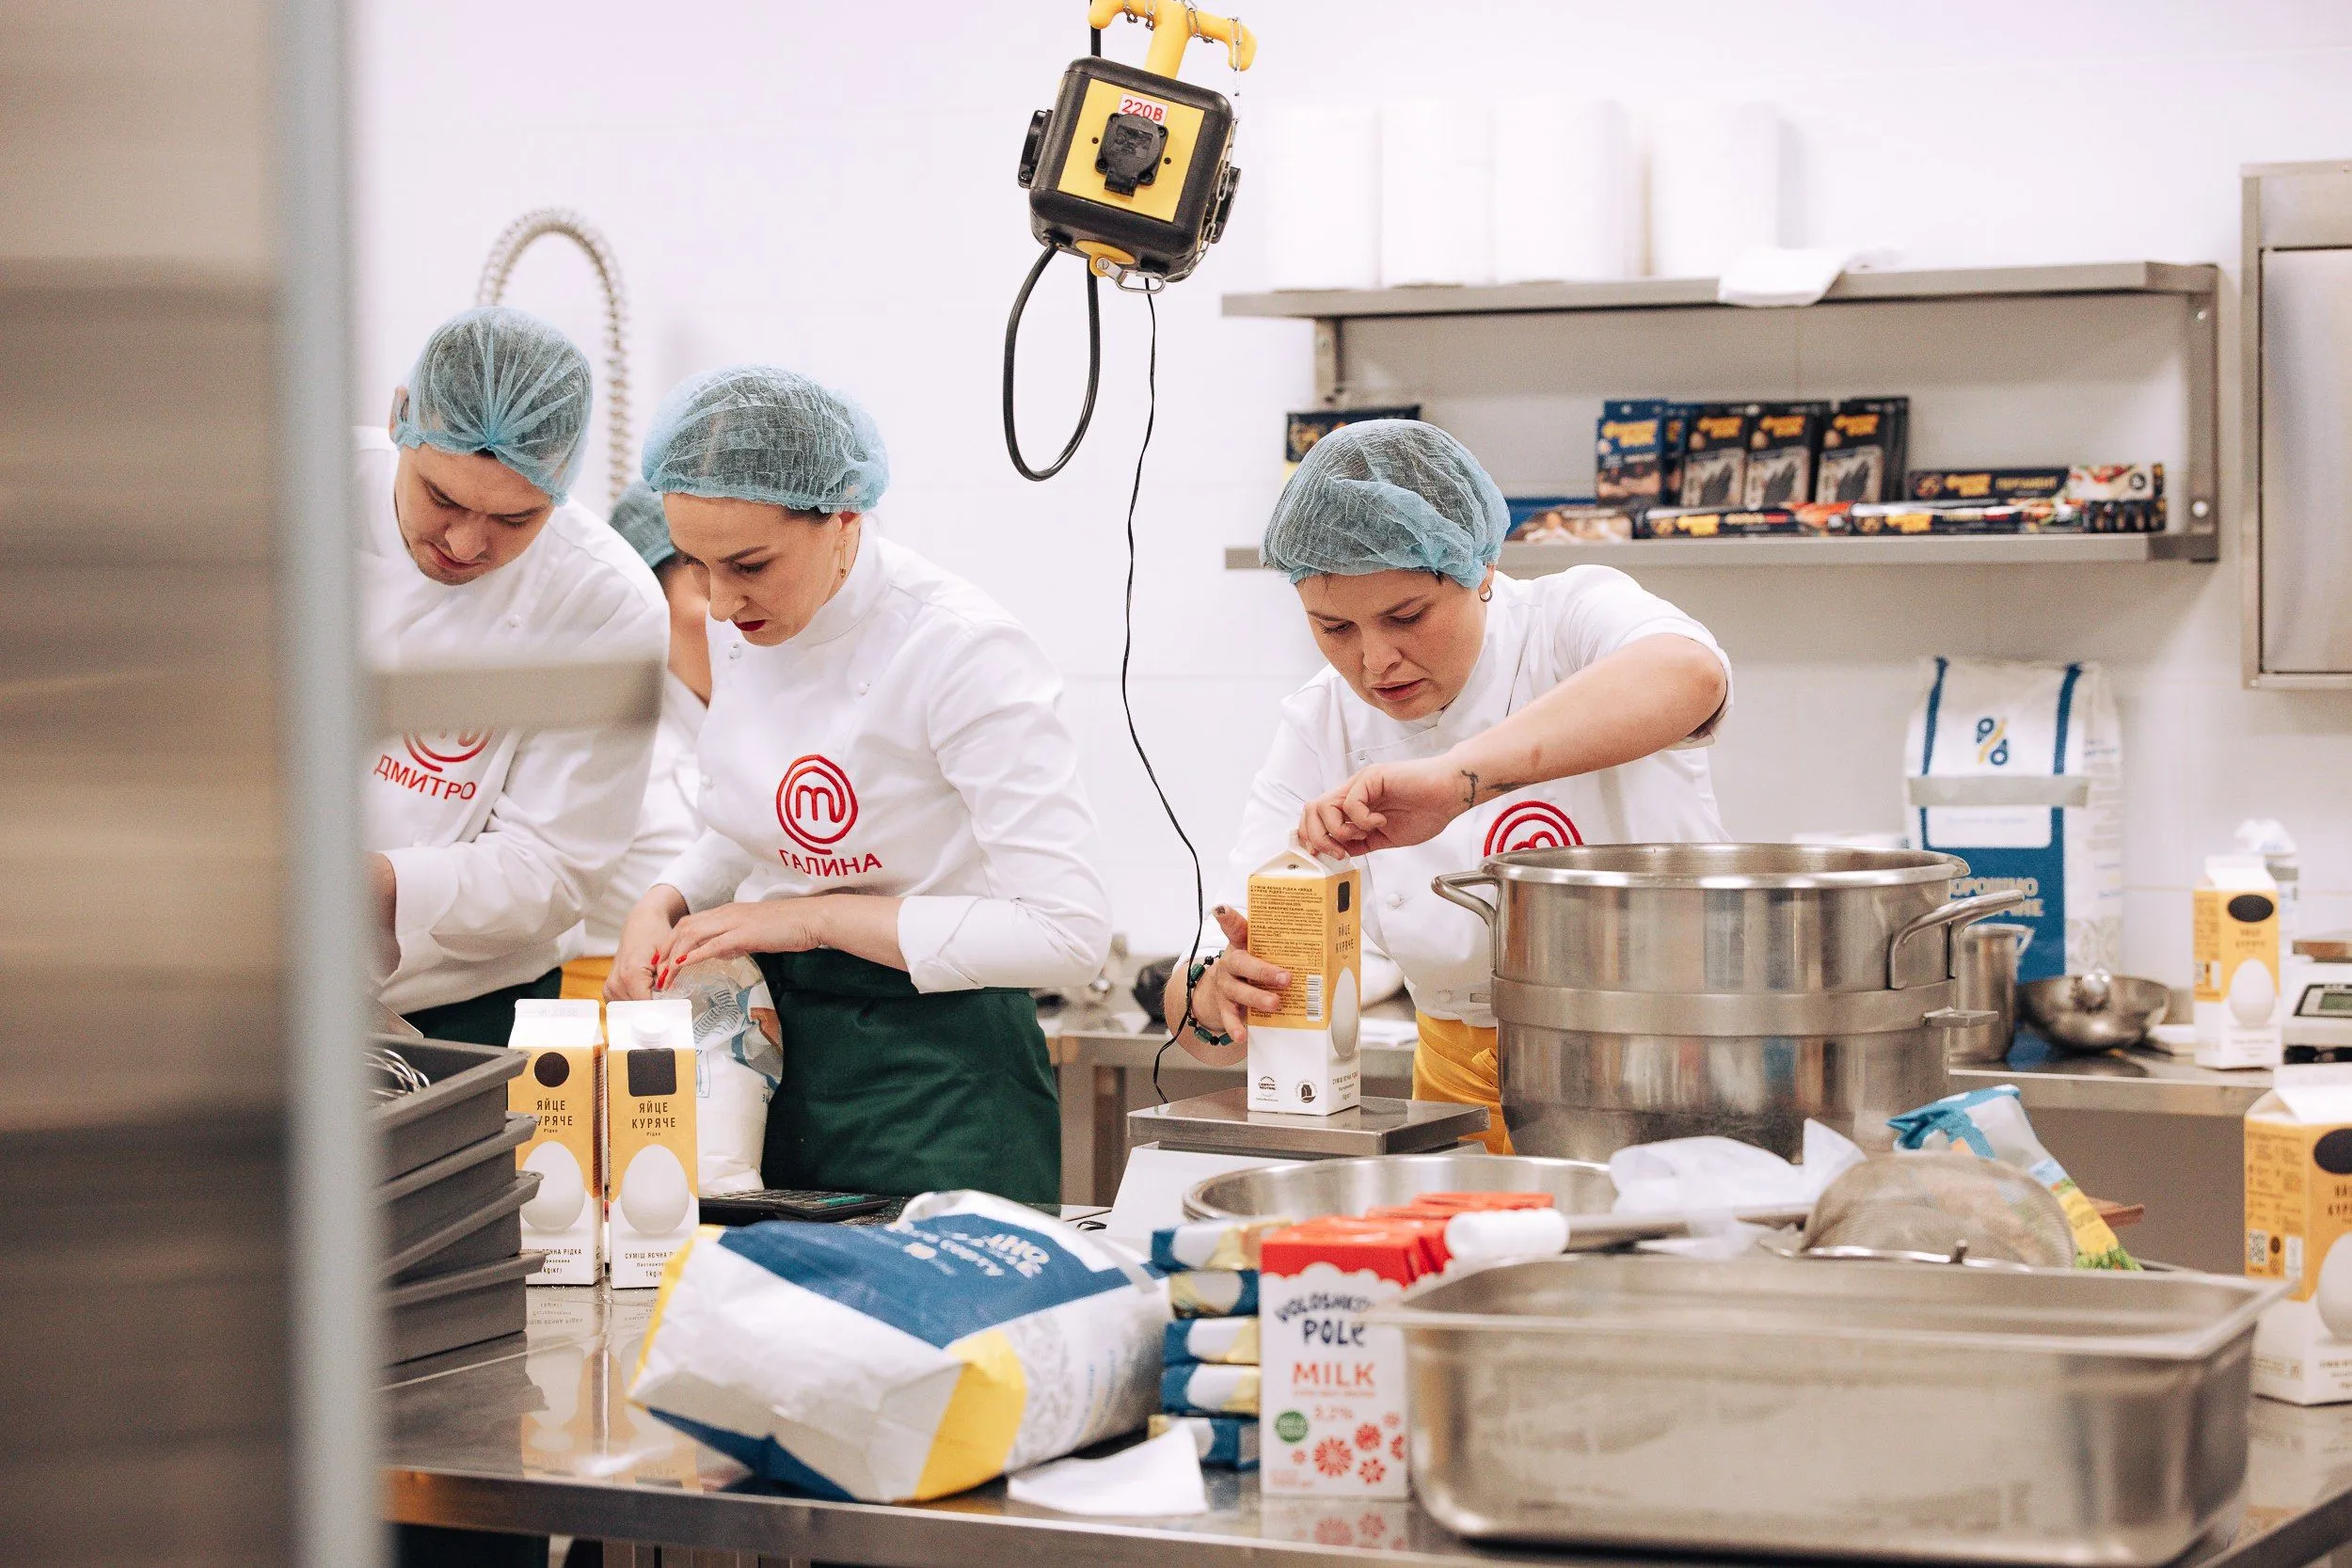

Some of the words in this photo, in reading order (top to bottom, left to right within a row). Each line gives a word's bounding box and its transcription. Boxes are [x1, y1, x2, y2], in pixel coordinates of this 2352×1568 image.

[373, 754, 477, 800] ДМИТРО
[779, 849, 882, 877] ГАЛИНА
[536, 1098, 565, 1112] ЯЙЦЕ
[639, 1101, 668, 1115] ЯЙЦЕ
[537, 1116, 573, 1127] УРЯЧЕ
[631, 1117, 676, 1129] КУРЯЧЕ
[1293, 1361, 1375, 1386] MILK
